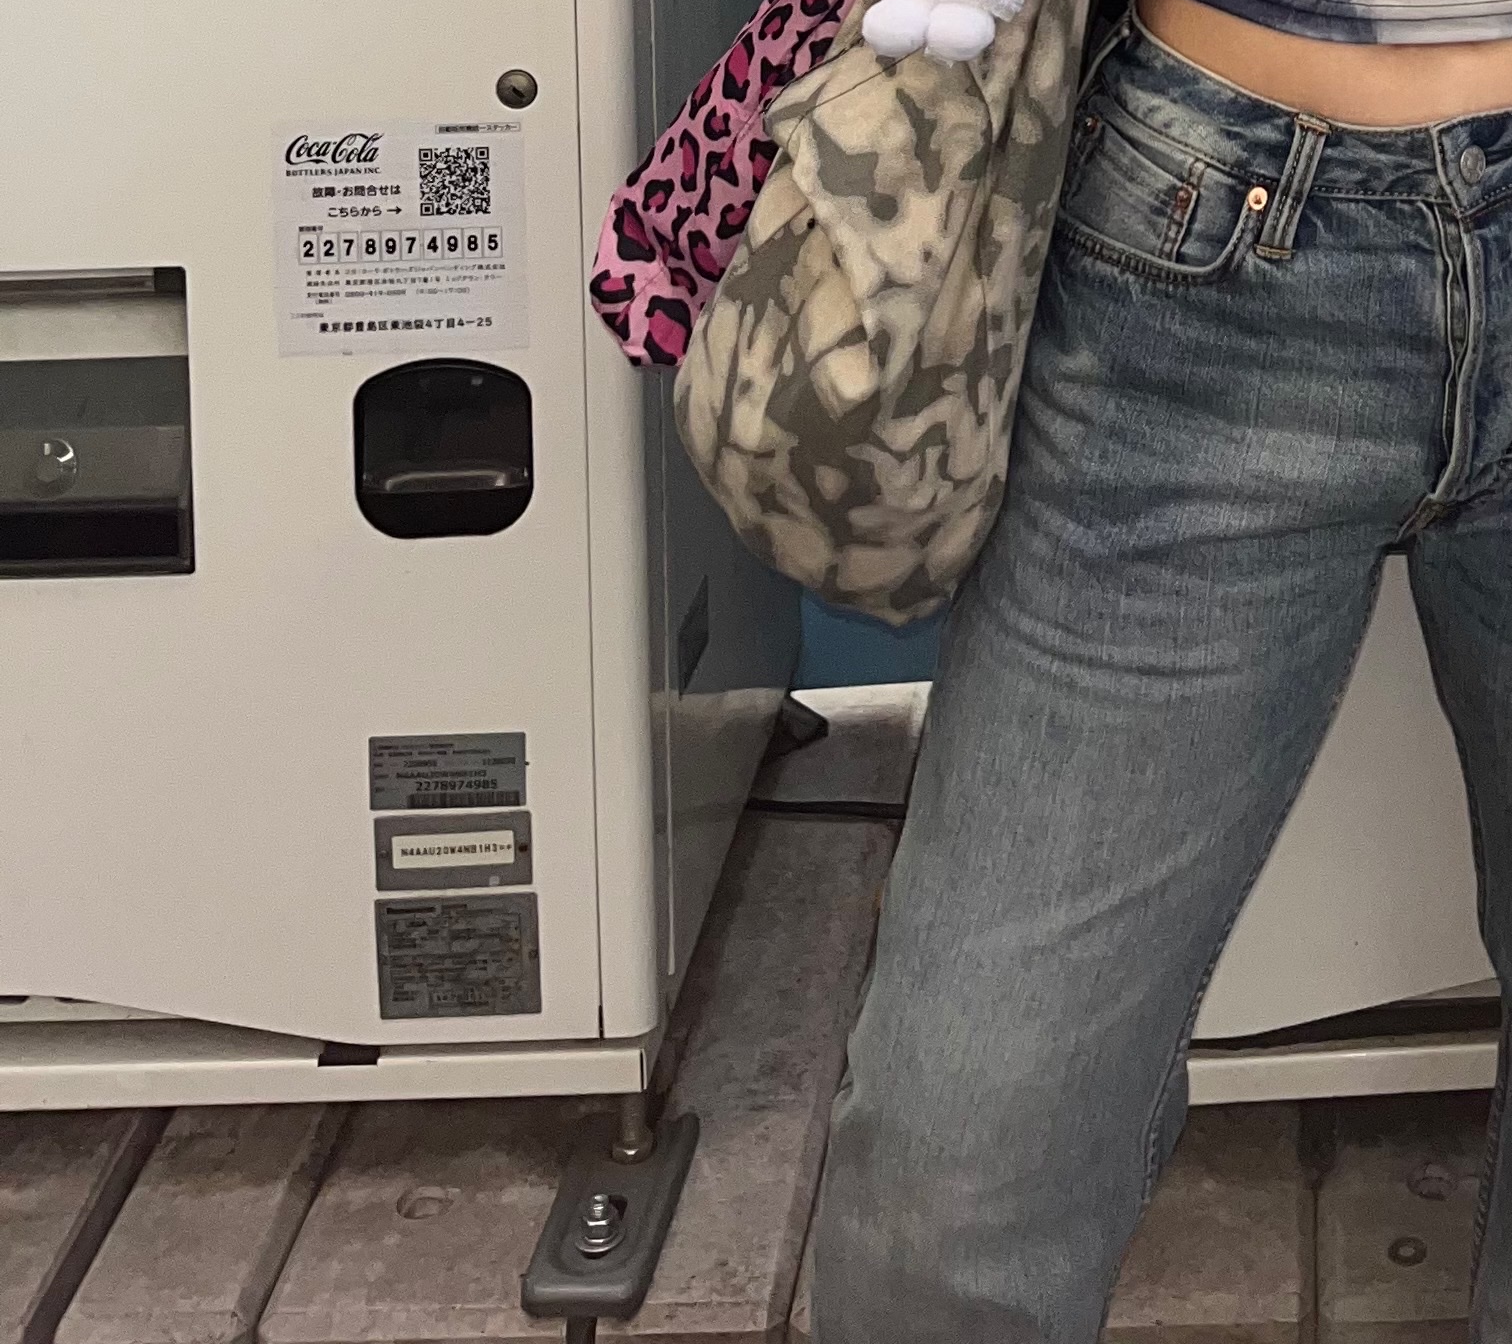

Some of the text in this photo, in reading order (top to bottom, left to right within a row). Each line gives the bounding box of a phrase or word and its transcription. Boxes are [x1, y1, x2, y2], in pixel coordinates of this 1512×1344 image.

[286, 133, 384, 165] Coca-Cola
[328, 206, 382, 217] こちらから
